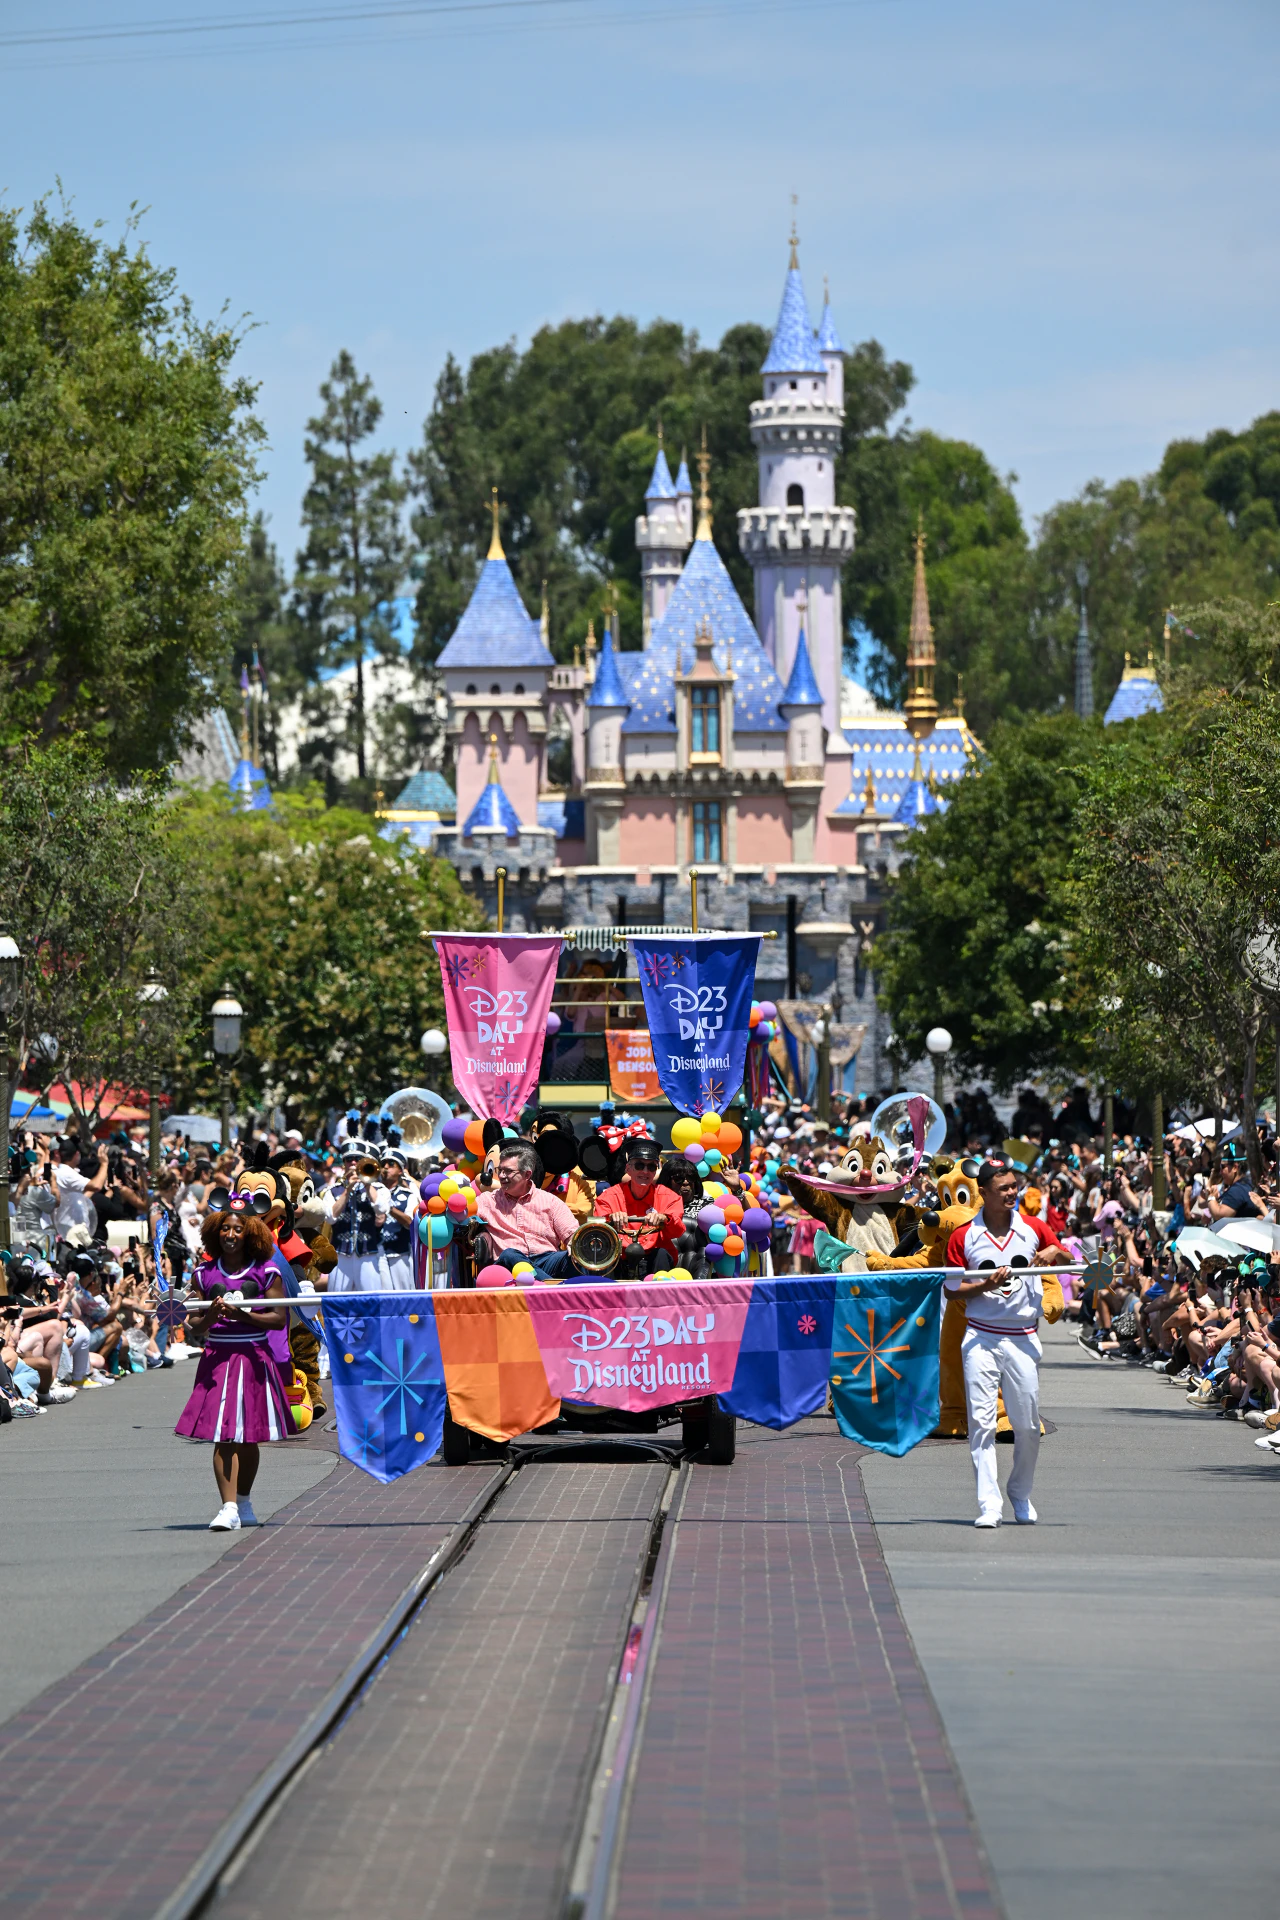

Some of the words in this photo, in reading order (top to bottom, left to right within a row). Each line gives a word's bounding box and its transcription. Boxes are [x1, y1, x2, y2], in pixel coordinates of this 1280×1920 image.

[463, 986, 528, 1017] D23
[663, 983, 728, 1014] D23
[477, 1019, 524, 1044] DAY
[679, 1015, 723, 1040] DAY
[490, 1046, 505, 1056] AT
[625, 1046, 651, 1058] JODI
[693, 1042, 706, 1053] AT
[464, 1056, 527, 1077] Disneyland
[667, 1052, 731, 1073] Disneyland
[563, 1313, 651, 1352] D23
[652, 1313, 715, 1346] DAY
[631, 1349, 651, 1362] AT
[567, 1352, 712, 1394] Disneyland
